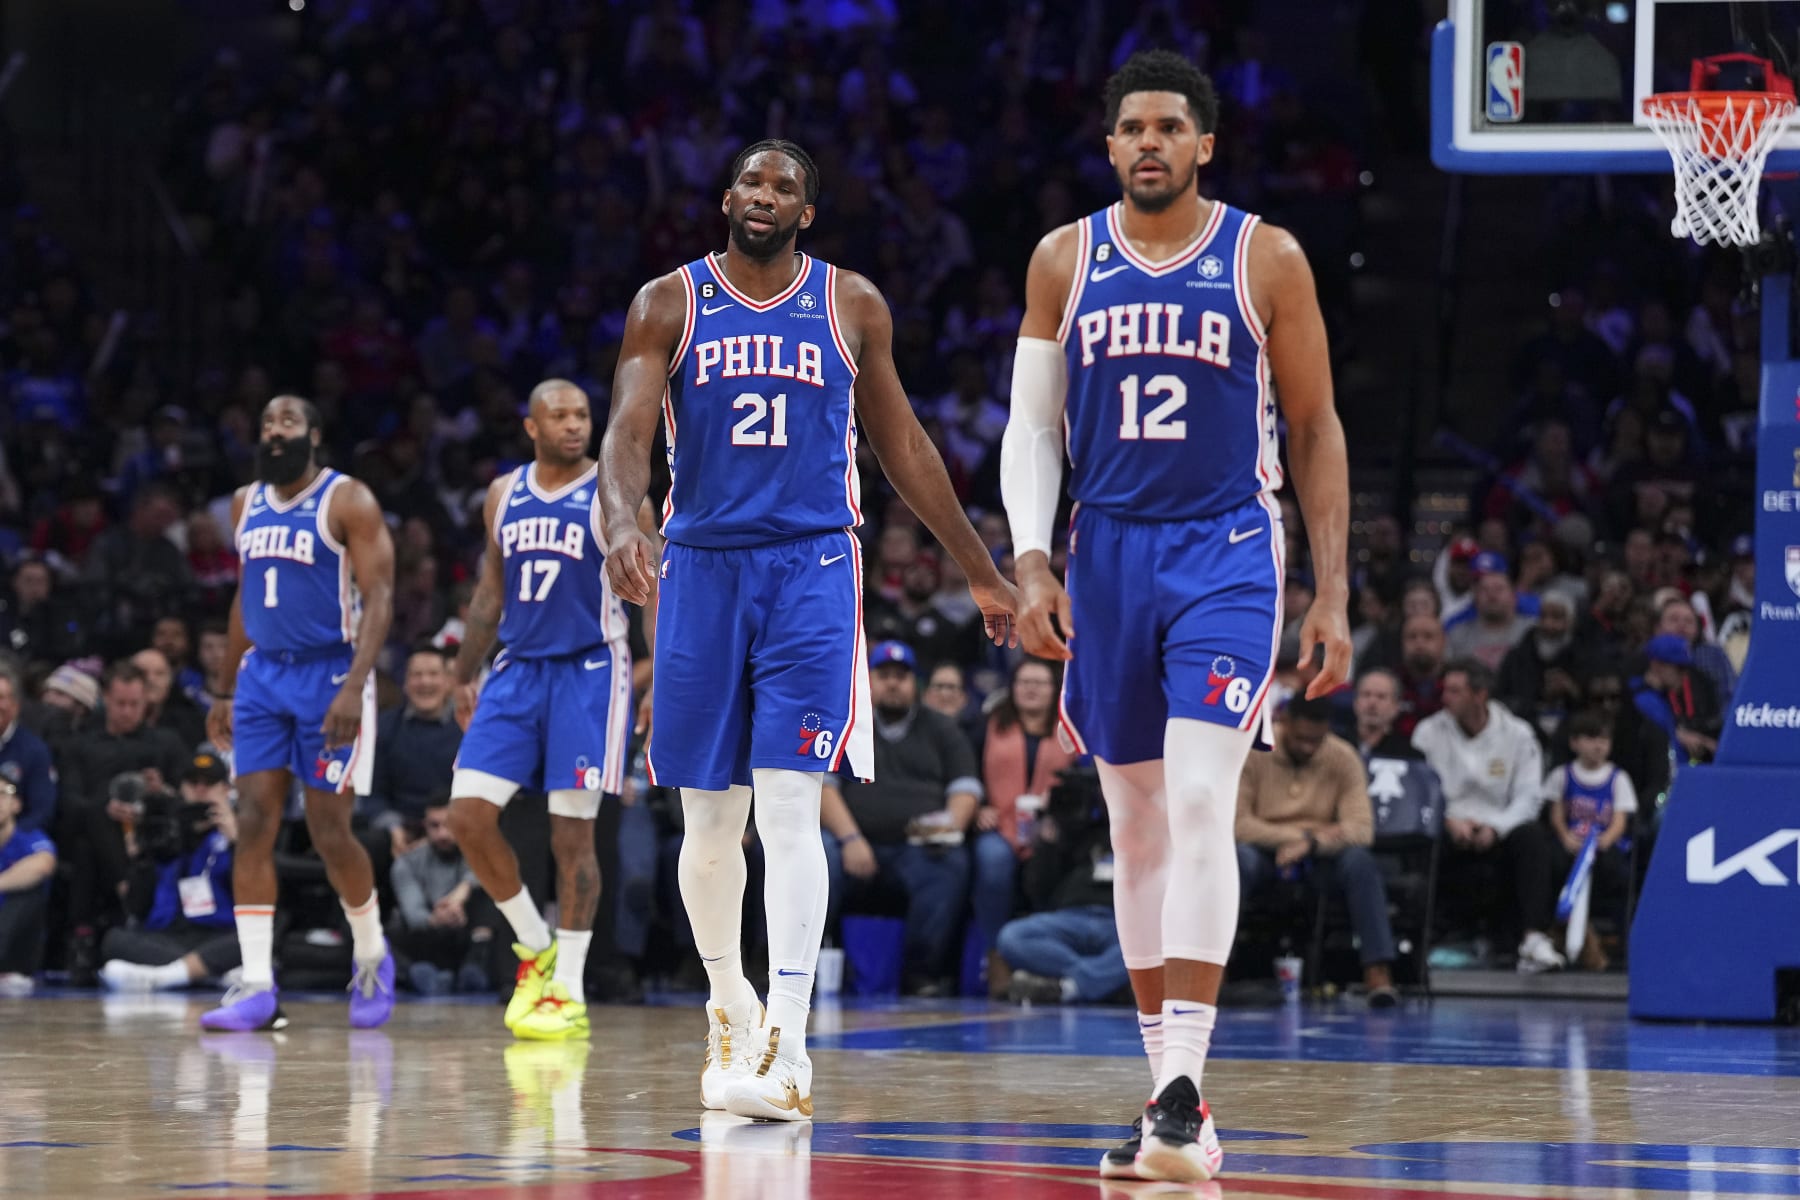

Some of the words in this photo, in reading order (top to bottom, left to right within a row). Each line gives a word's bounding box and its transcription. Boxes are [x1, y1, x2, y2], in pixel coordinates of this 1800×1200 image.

[1096, 243, 1110, 261] 6
[702, 284, 713, 297] 6
[1186, 280, 1232, 289] crypto.com
[789, 312, 825, 320] crypto.com
[1078, 302, 1231, 368] PHILA
[695, 334, 824, 388] PHILA
[732, 392, 788, 446] 21
[1119, 374, 1188, 439] 12
[240, 525, 315, 566] PHILA
[501, 516, 584, 560] PHILA
[264, 566, 279, 608] 1
[518, 559, 561, 602] 17
[1203, 671, 1252, 713] 76
[1735, 701, 1800, 728] ticket
[796, 727, 833, 759] 76
